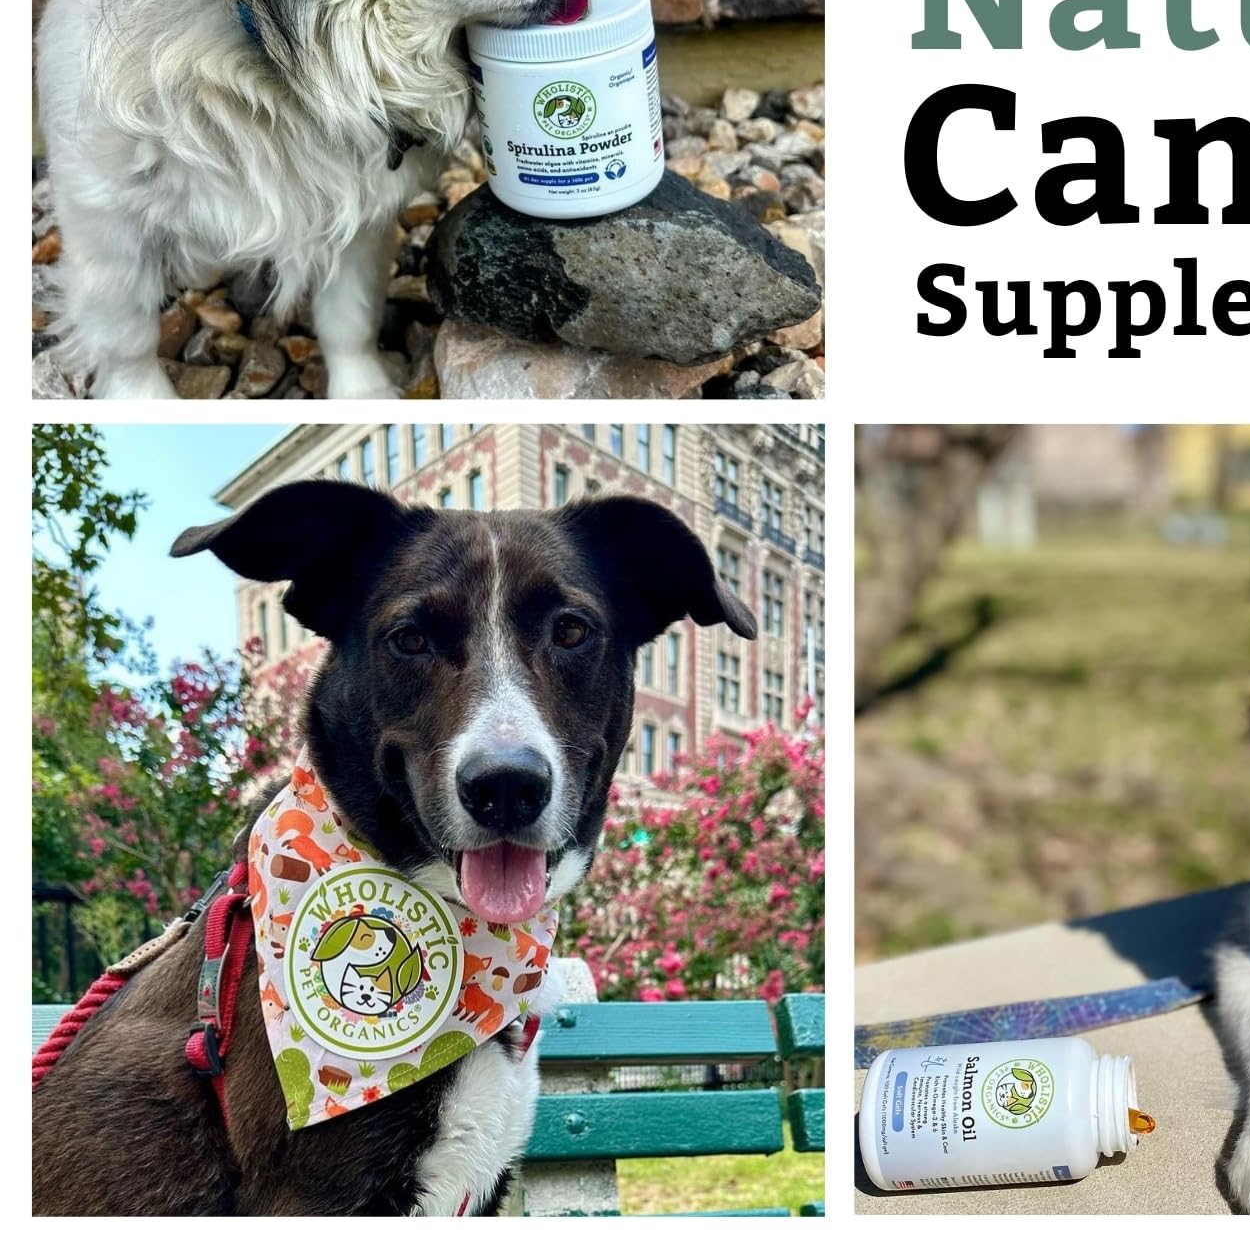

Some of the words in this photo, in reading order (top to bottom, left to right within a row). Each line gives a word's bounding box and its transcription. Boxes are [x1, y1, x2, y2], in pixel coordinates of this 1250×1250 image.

[537, 84, 591, 105] WHOLISTIC
[542, 120, 552, 130] PET
[507, 141, 576, 156] Spirulina
[580, 132, 632, 154] Powder
[309, 880, 450, 972] WHOLISTIC
[300, 967, 318, 1000] PET
[995, 1066, 1008, 1078] PET
[941, 1075, 949, 1098] Promotes
[962, 1057, 980, 1112] Salmon
[1024, 1062, 1050, 1123] WHOLISTIC
[962, 1117, 976, 1142] Oil
